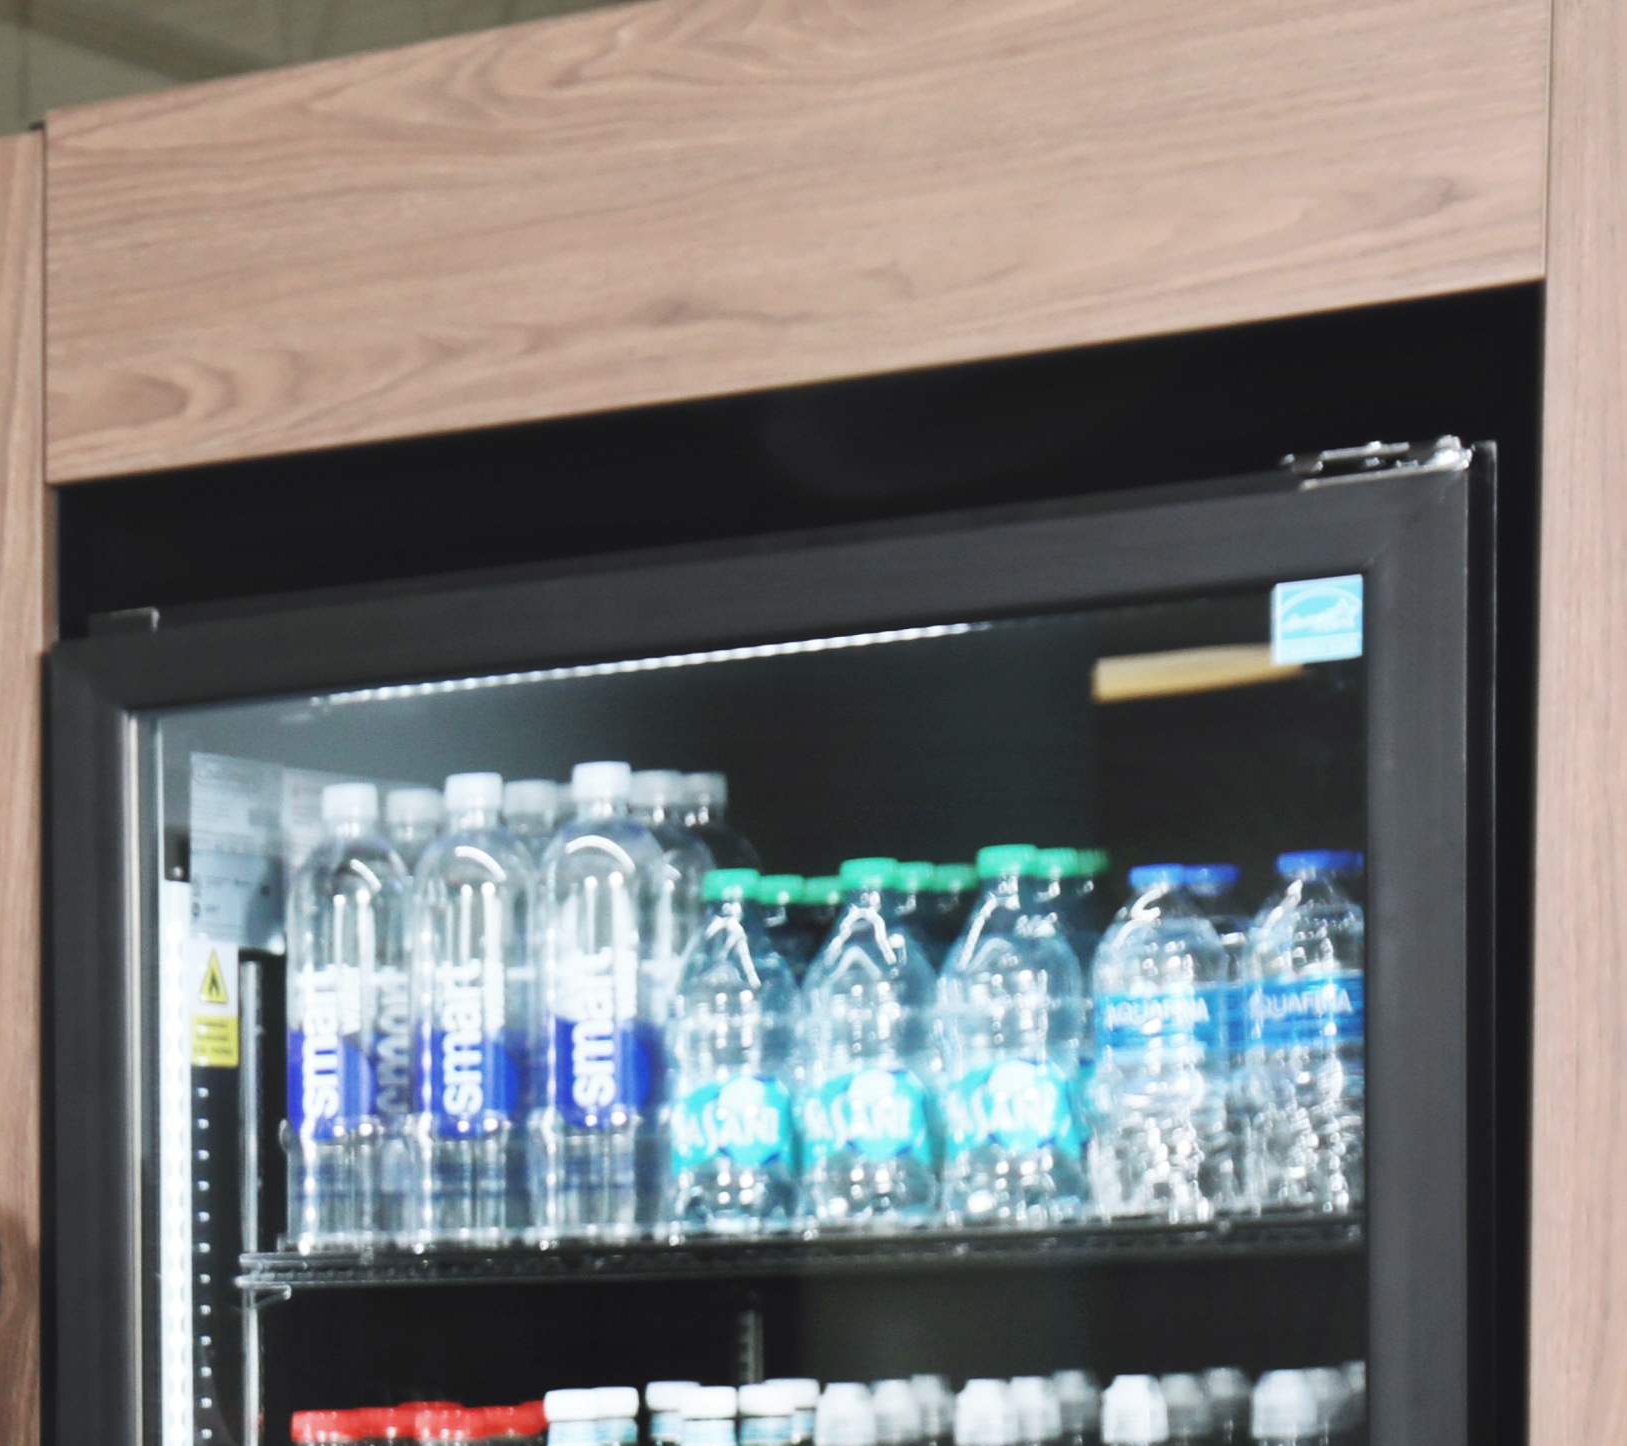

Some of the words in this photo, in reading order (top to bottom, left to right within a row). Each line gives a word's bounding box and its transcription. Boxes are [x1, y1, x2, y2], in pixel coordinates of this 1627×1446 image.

[443, 956, 482, 1116] smart
[572, 947, 616, 1108] smart
[1104, 997, 1210, 1028] AQUAFINA
